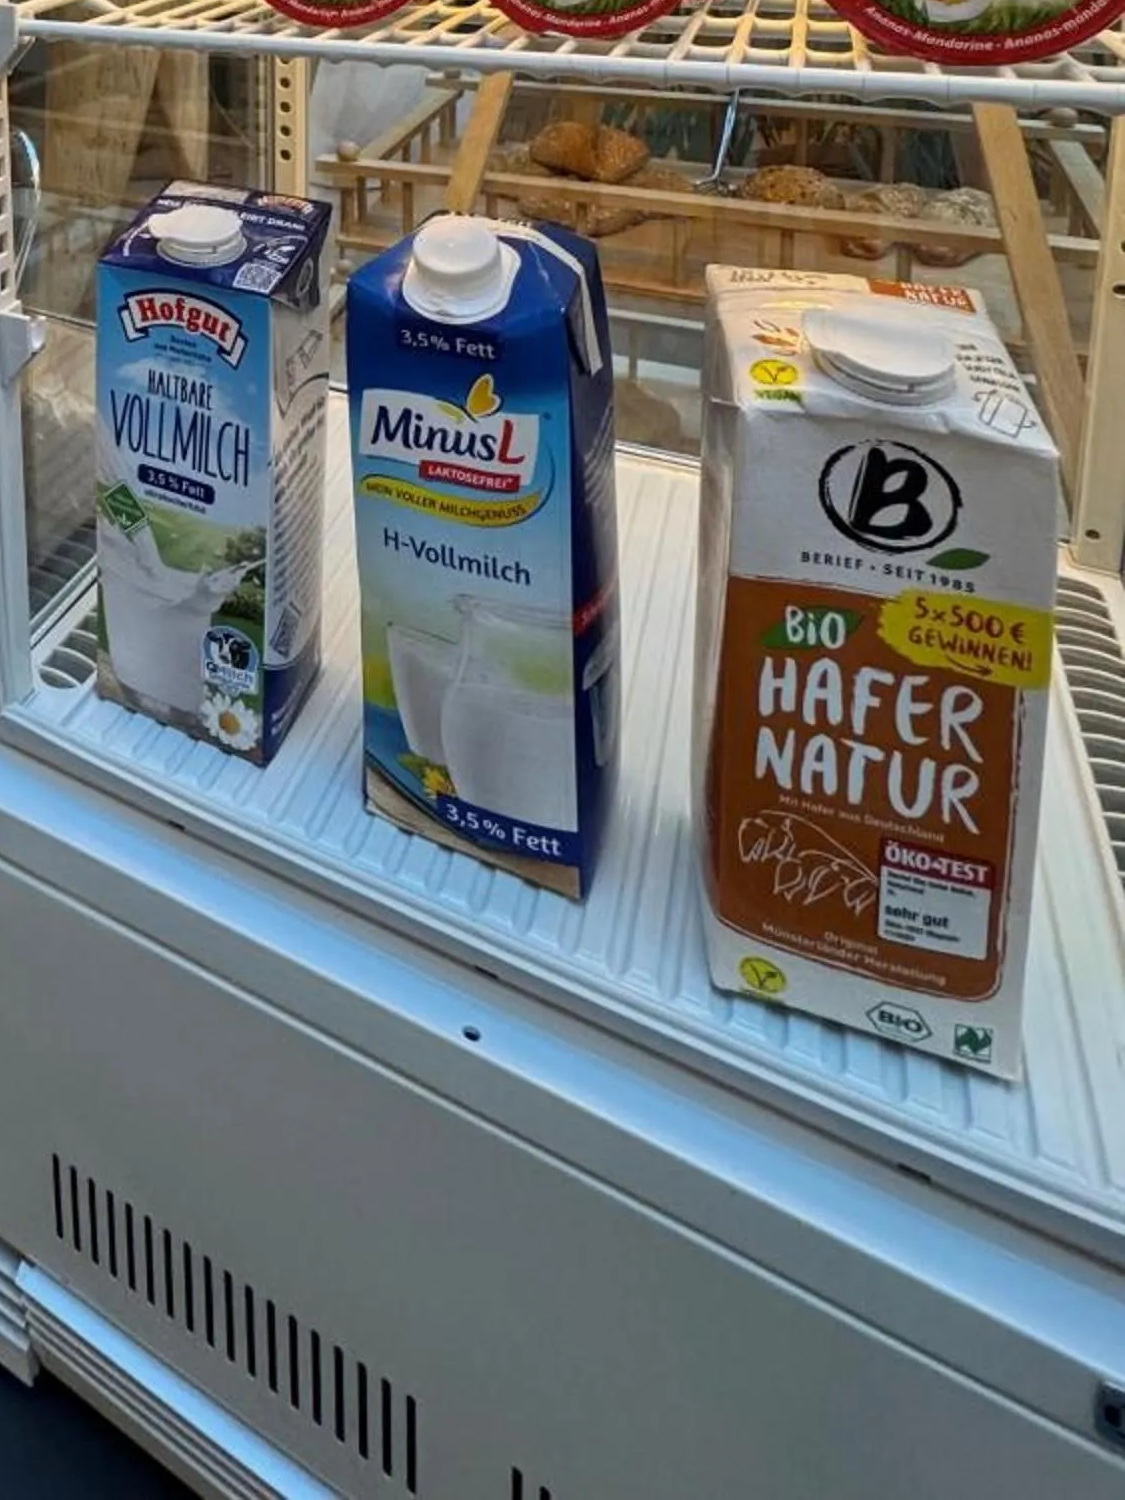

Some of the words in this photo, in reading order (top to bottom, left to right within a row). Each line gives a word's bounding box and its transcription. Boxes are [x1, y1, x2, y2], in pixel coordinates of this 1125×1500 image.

[136, 297, 231, 343] Hofgut
[456, 337, 496, 359] Fett
[148, 369, 214, 411] HALTBARE
[111, 390, 250, 487] VOLLMILCH
[371, 405, 526, 465] MinusL
[395, 488, 436, 512] VOLLER
[383, 528, 531, 586] H-Vollmilch
[800, 551, 864, 572] BERIEF
[883, 563, 925, 583] SEIT
[929, 573, 976, 594] 1985
[758, 656, 985, 764] HAFER
[755, 725, 982, 835] NATUR
[512, 825, 562, 858] Fett
[884, 839, 989, 884] ÖKO-TEST
[884, 904, 920, 922] sehr
[922, 913, 950, 929] gut
